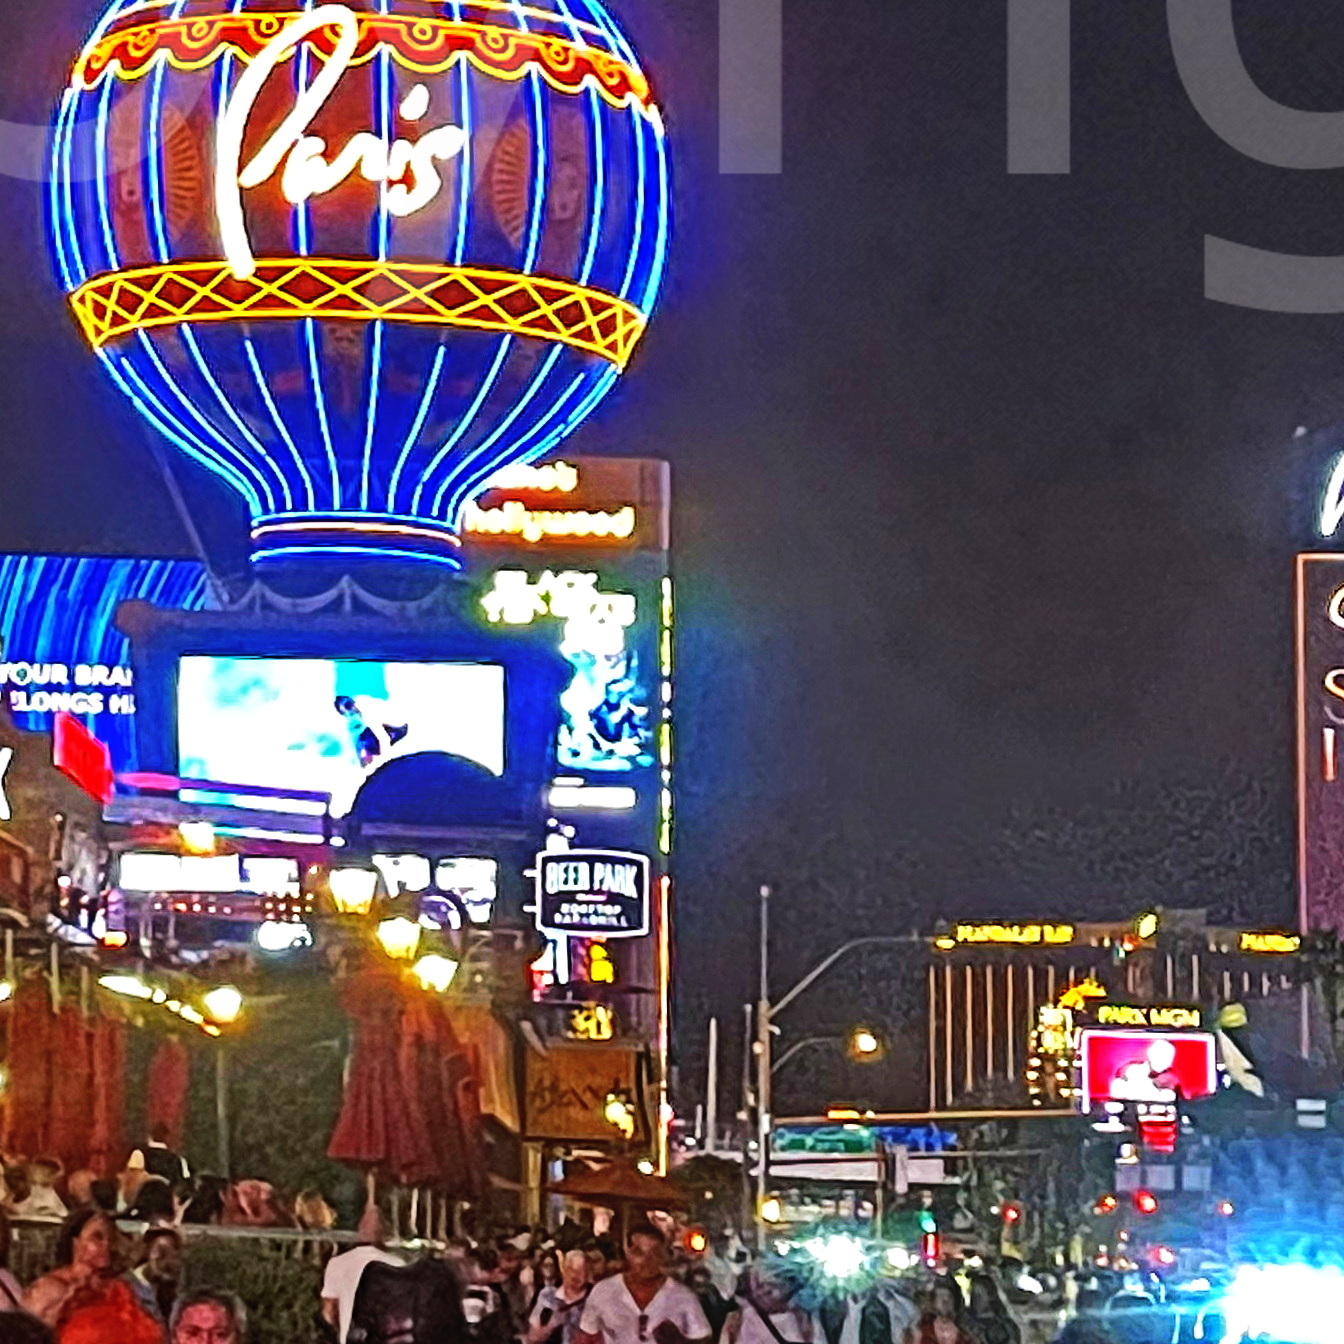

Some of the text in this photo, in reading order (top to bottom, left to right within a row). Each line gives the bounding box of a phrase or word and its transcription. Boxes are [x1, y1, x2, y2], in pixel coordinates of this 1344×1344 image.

[216, 4, 467, 278] Paris
[545, 862, 638, 899] BEER PARK
[1098, 1006, 1200, 1027] PARK MGM
